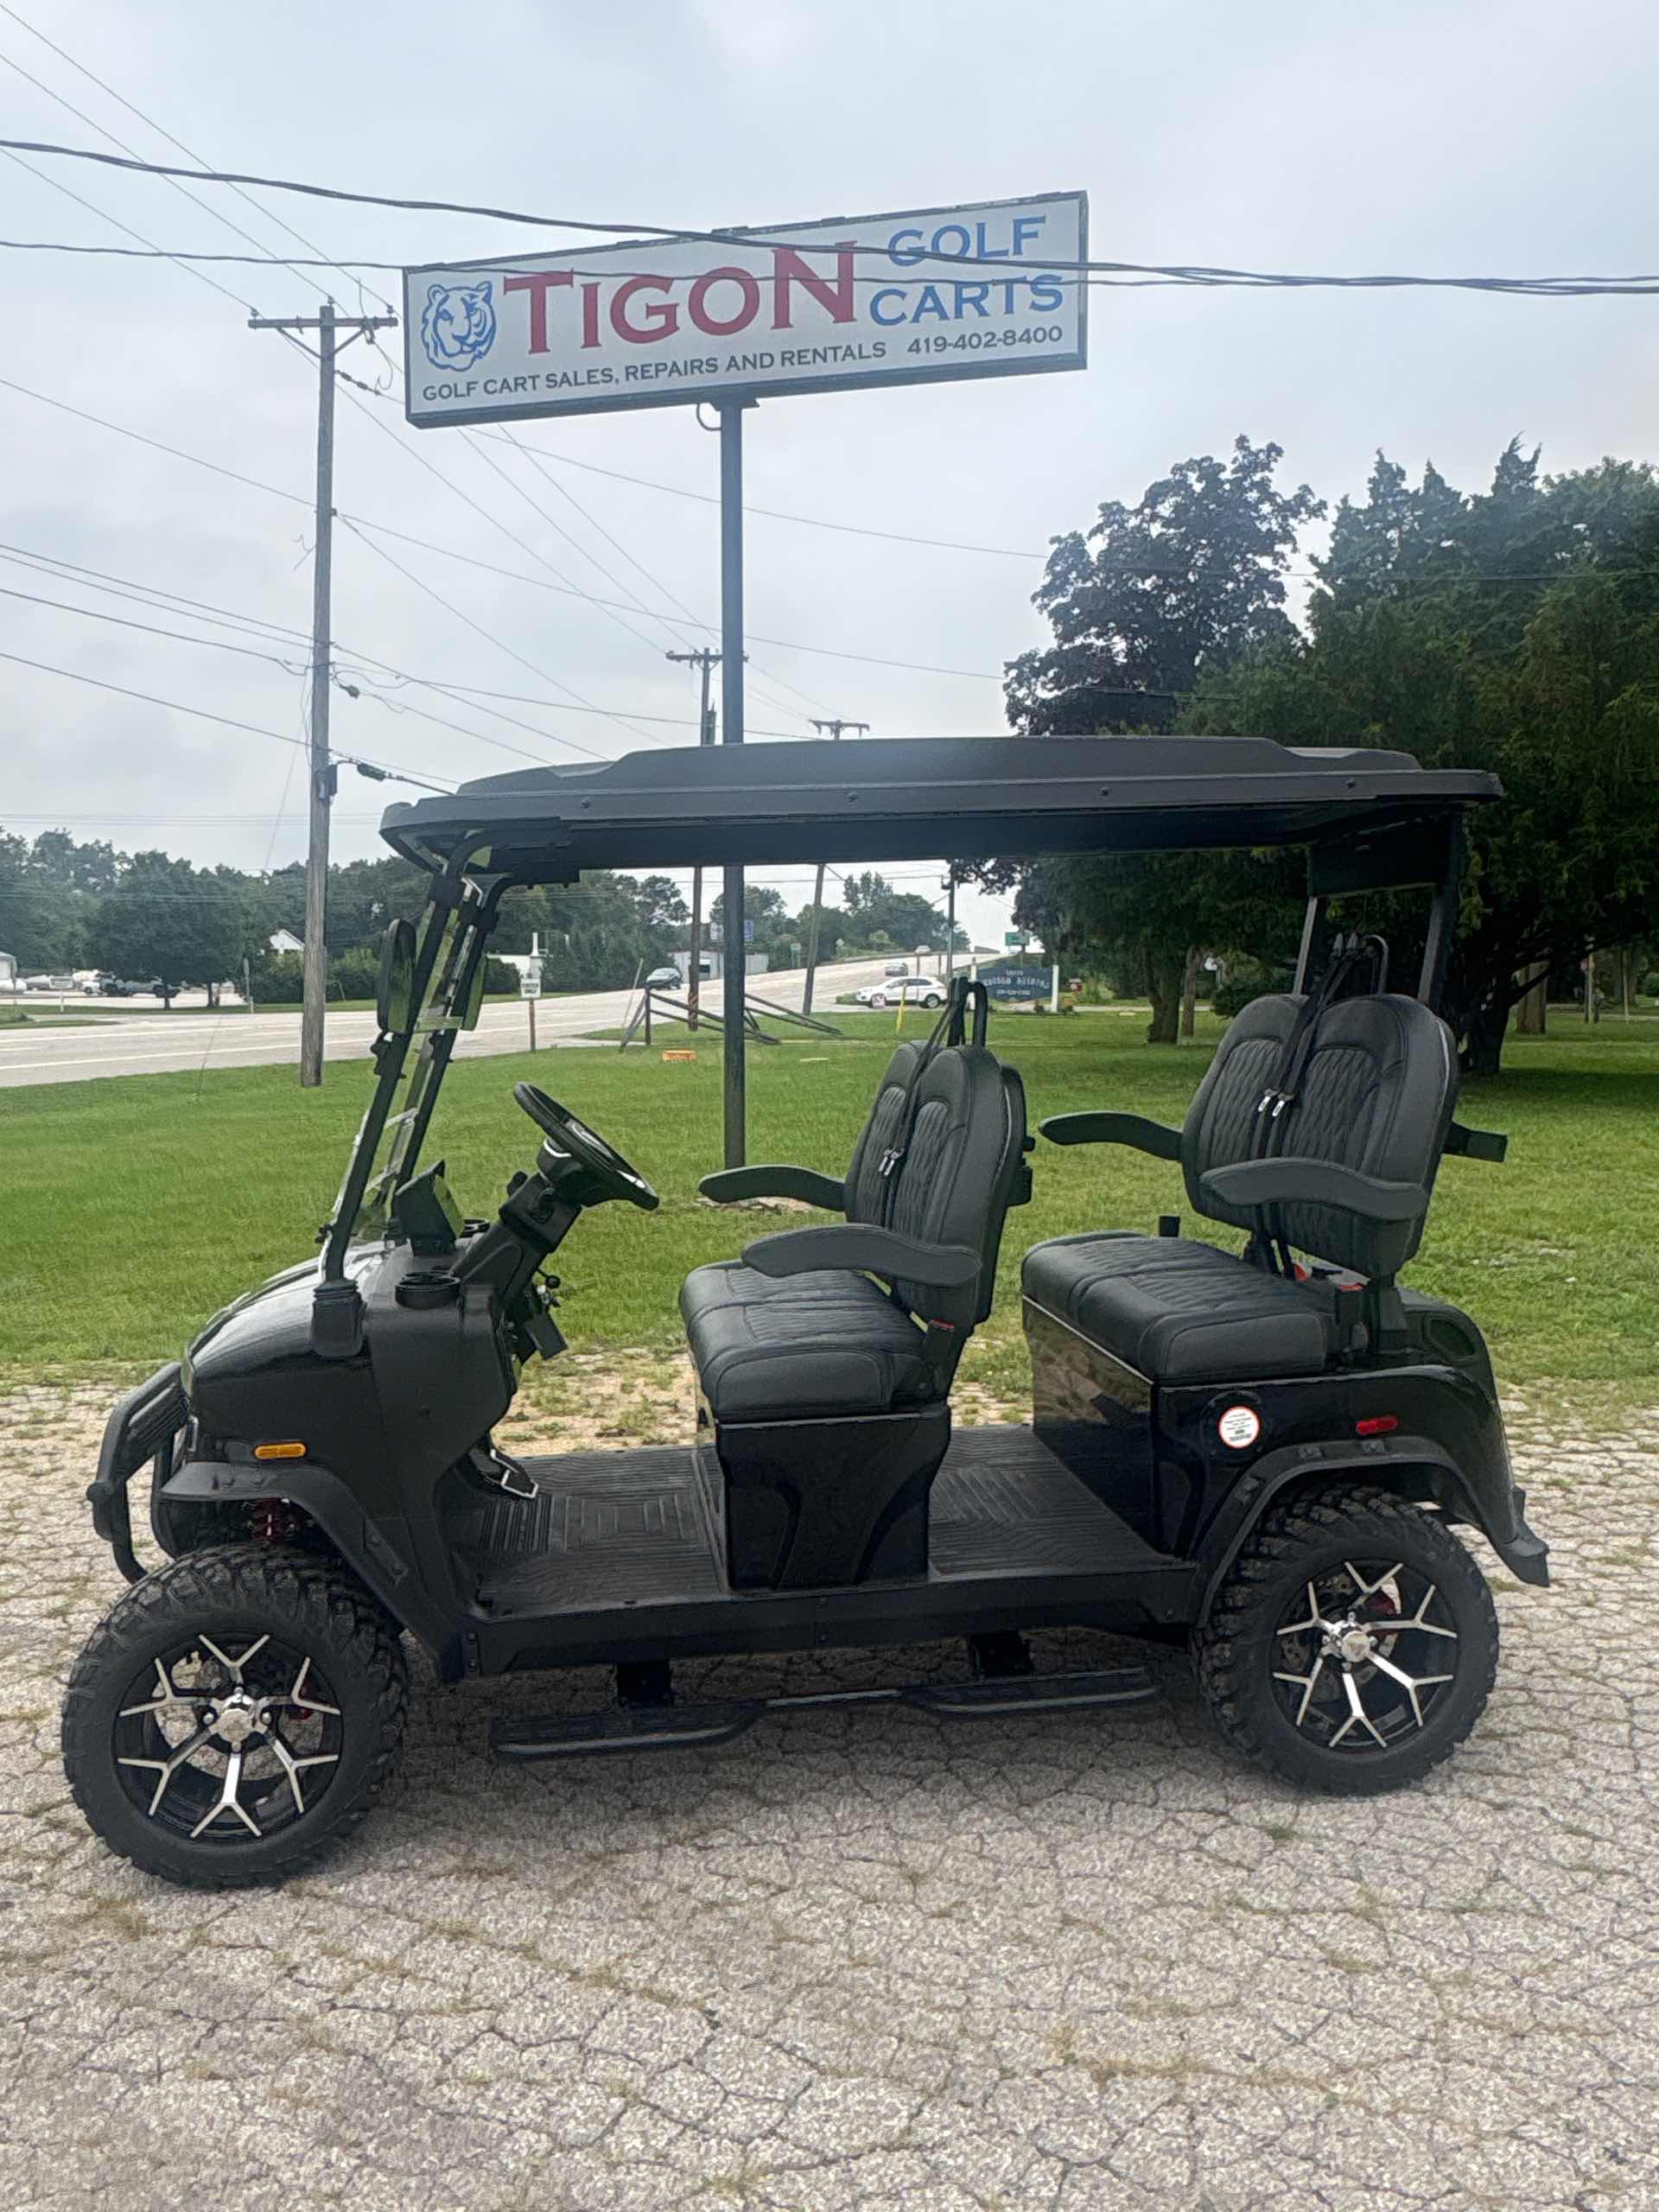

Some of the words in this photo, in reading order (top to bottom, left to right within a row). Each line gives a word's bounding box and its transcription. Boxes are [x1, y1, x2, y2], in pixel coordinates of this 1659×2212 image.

[887, 215, 1046, 266] GOLF
[504, 240, 857, 354] TIGON
[869, 274, 1063, 326] CARTS
[423, 380, 479, 401] GOLF
[483, 374, 540, 395] CART
[545, 366, 620, 389] SALES,
[625, 357, 718, 381] REPAIRS
[725, 353, 774, 372] AND
[781, 341, 887, 366] RENTALS
[907, 326, 1063, 354] 419-402-8400
